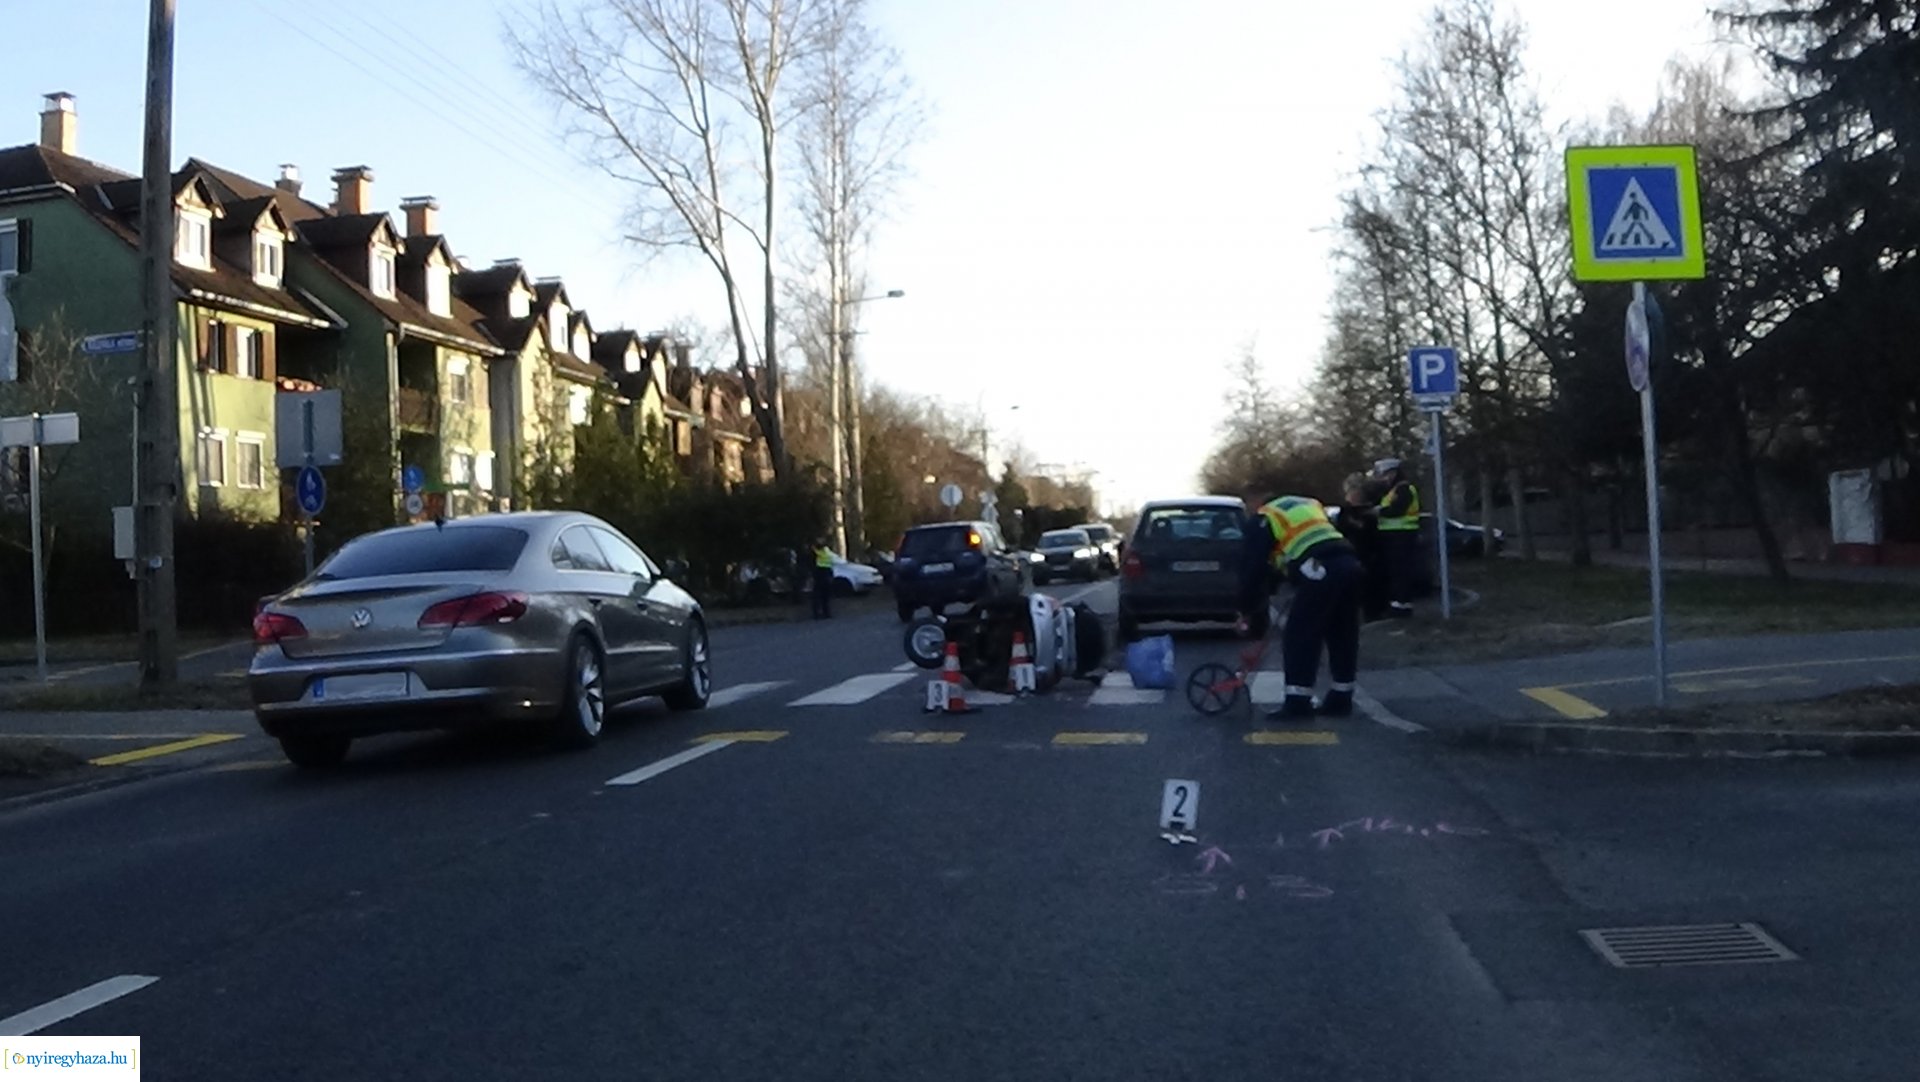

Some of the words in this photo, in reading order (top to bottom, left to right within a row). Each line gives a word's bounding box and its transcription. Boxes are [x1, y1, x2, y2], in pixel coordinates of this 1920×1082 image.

[1419, 354, 1446, 390] P
[933, 682, 944, 703] 3
[1173, 785, 1188, 818] 2
